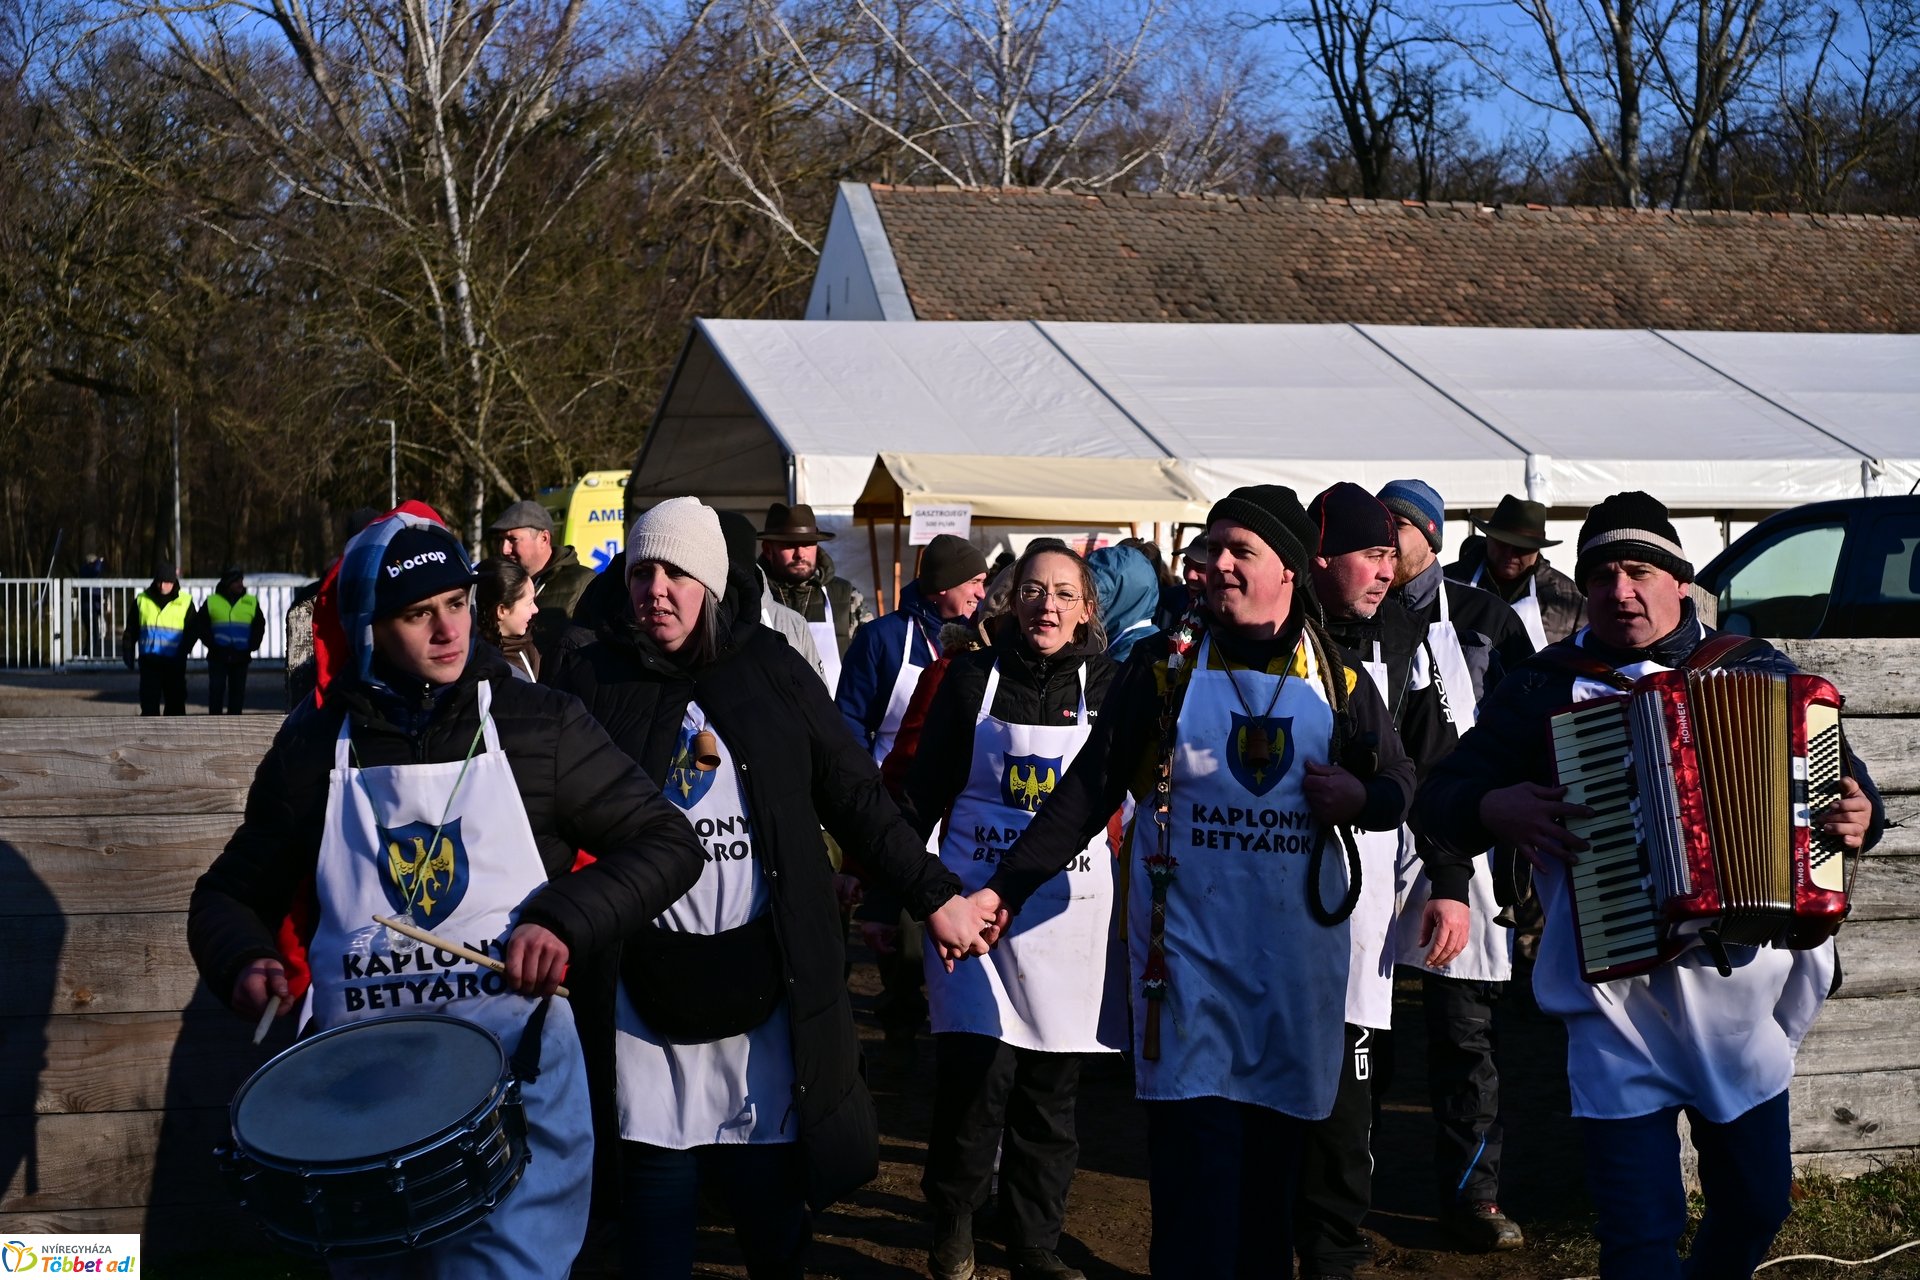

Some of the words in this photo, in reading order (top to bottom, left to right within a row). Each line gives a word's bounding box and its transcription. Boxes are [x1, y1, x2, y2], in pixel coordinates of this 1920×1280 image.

[386, 551, 447, 578] biocrop
[1677, 702, 1690, 743] HOHNER
[1192, 804, 1311, 830] KAPLONYI
[1191, 828, 1311, 855] BETYÁROK
[342, 939, 507, 980] KAPLONY
[344, 969, 507, 1012] BETYÁRO
